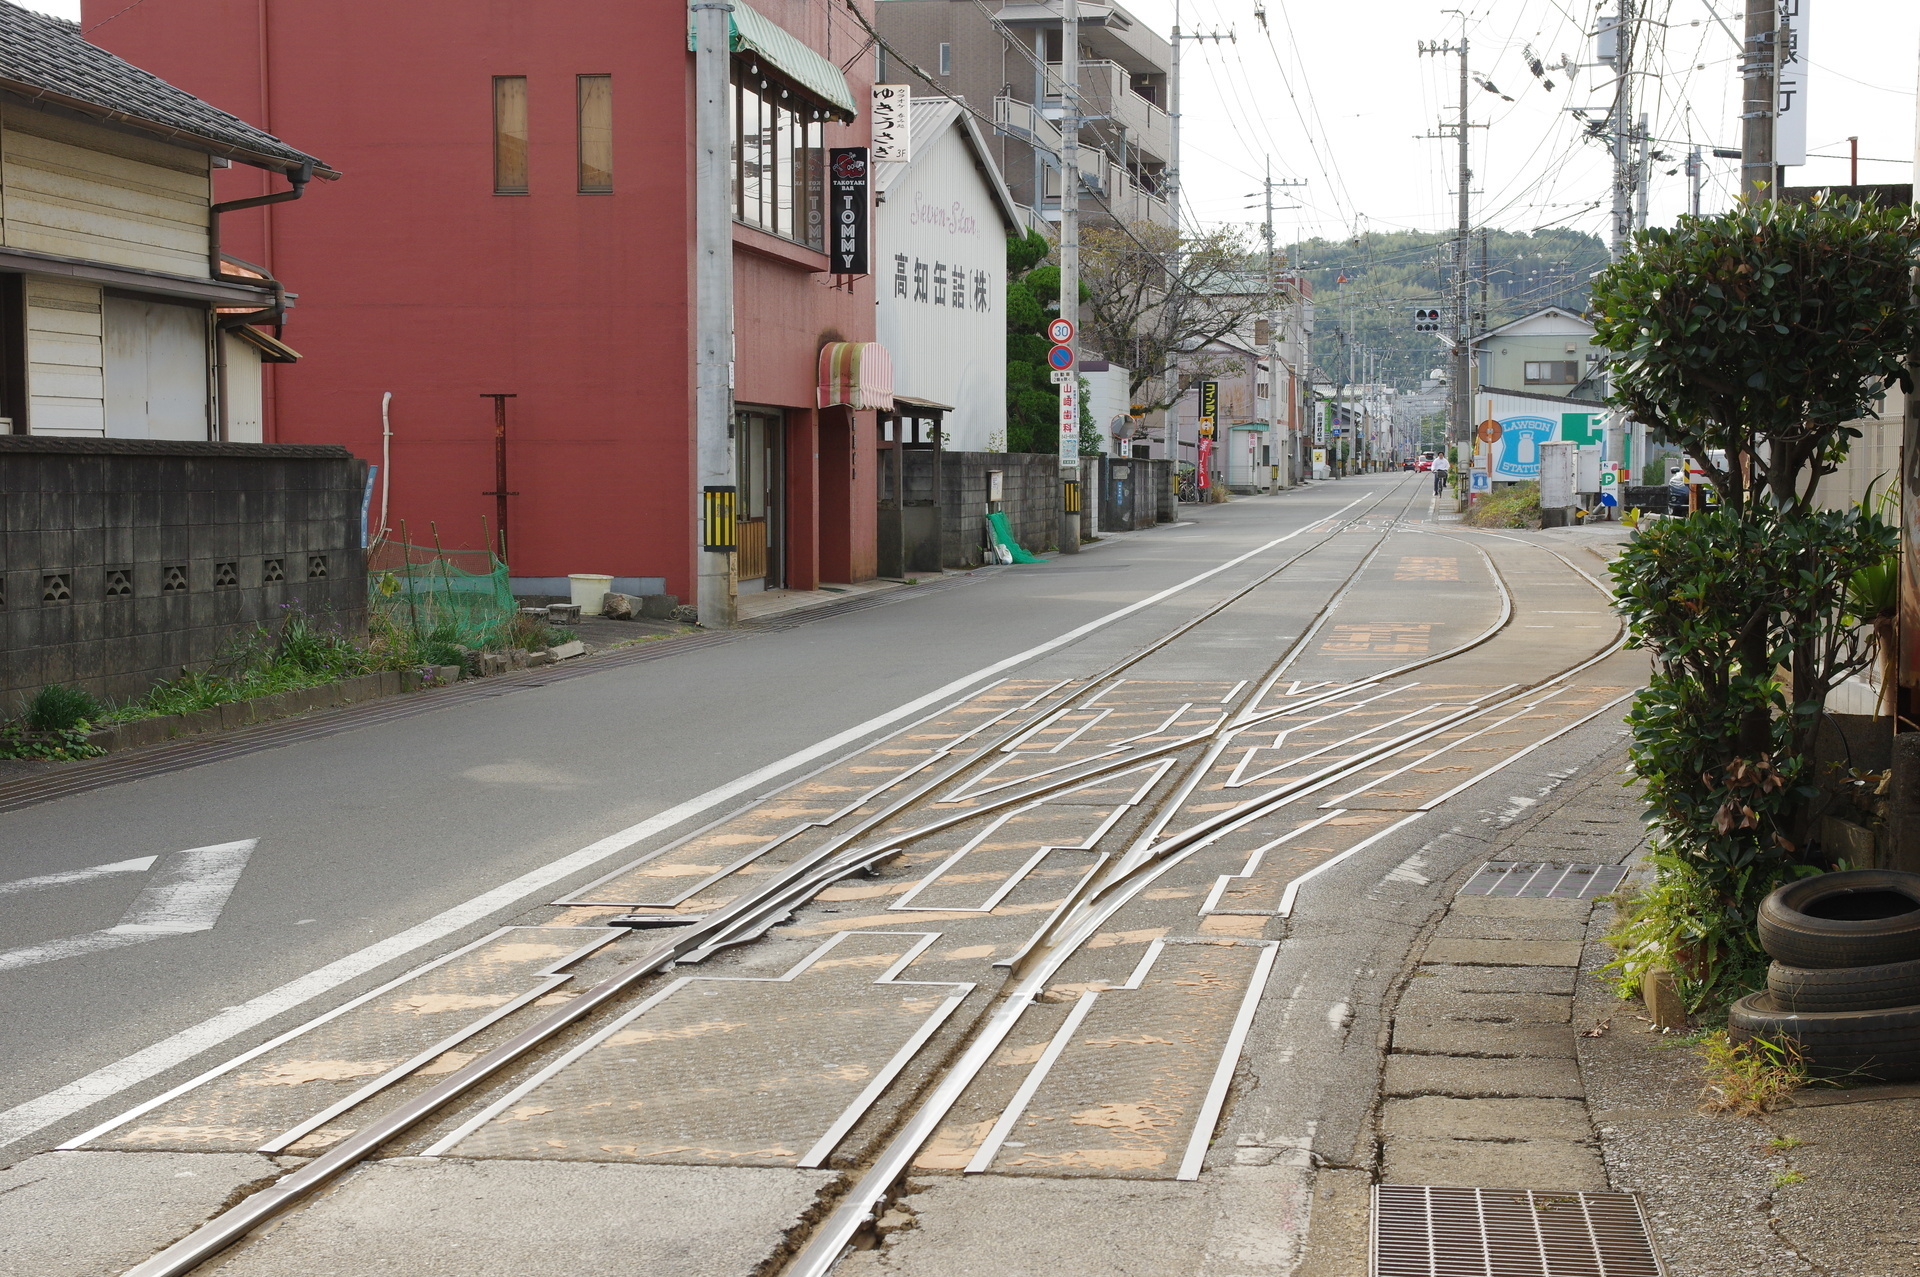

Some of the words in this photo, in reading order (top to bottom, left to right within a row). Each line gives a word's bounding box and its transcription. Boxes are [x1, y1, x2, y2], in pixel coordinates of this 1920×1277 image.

[873, 87, 895, 159] ゆきうさぎ
[896, 148, 906, 158] 3F
[840, 195, 856, 269] TOMMY
[1054, 325, 1069, 337] 30
[1502, 420, 1551, 432] LAWSON
[1605, 475, 1613, 484] P
